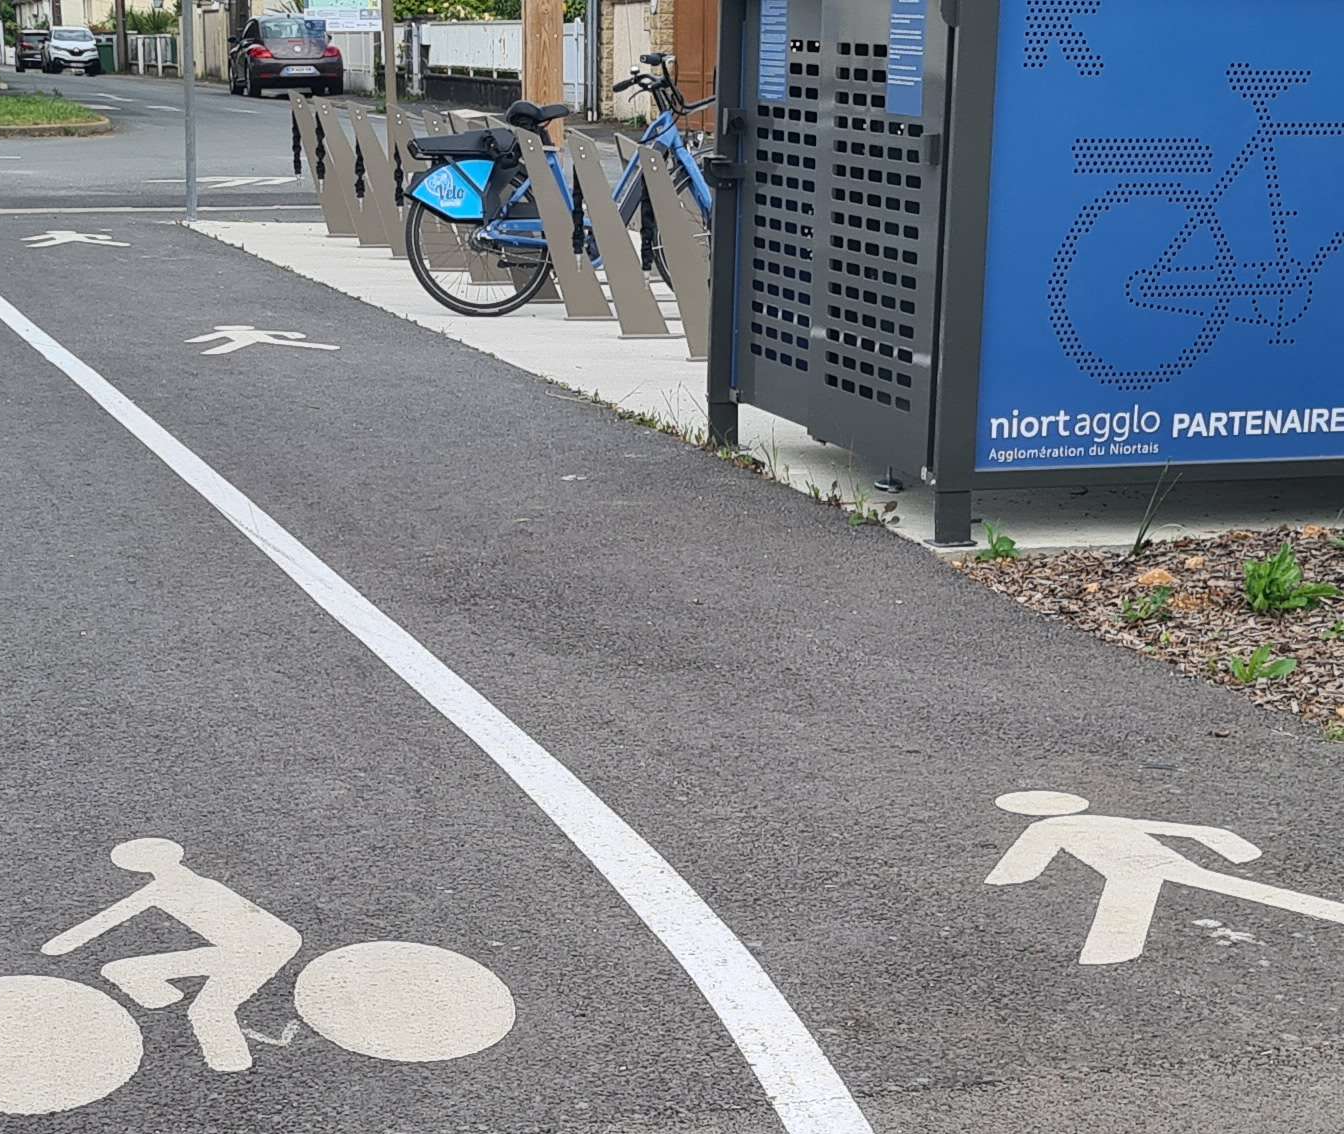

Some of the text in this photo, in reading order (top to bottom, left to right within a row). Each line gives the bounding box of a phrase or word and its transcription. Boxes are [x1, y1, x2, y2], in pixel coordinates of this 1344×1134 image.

[988, 441, 1159, 463] Agglomération du Niortais
